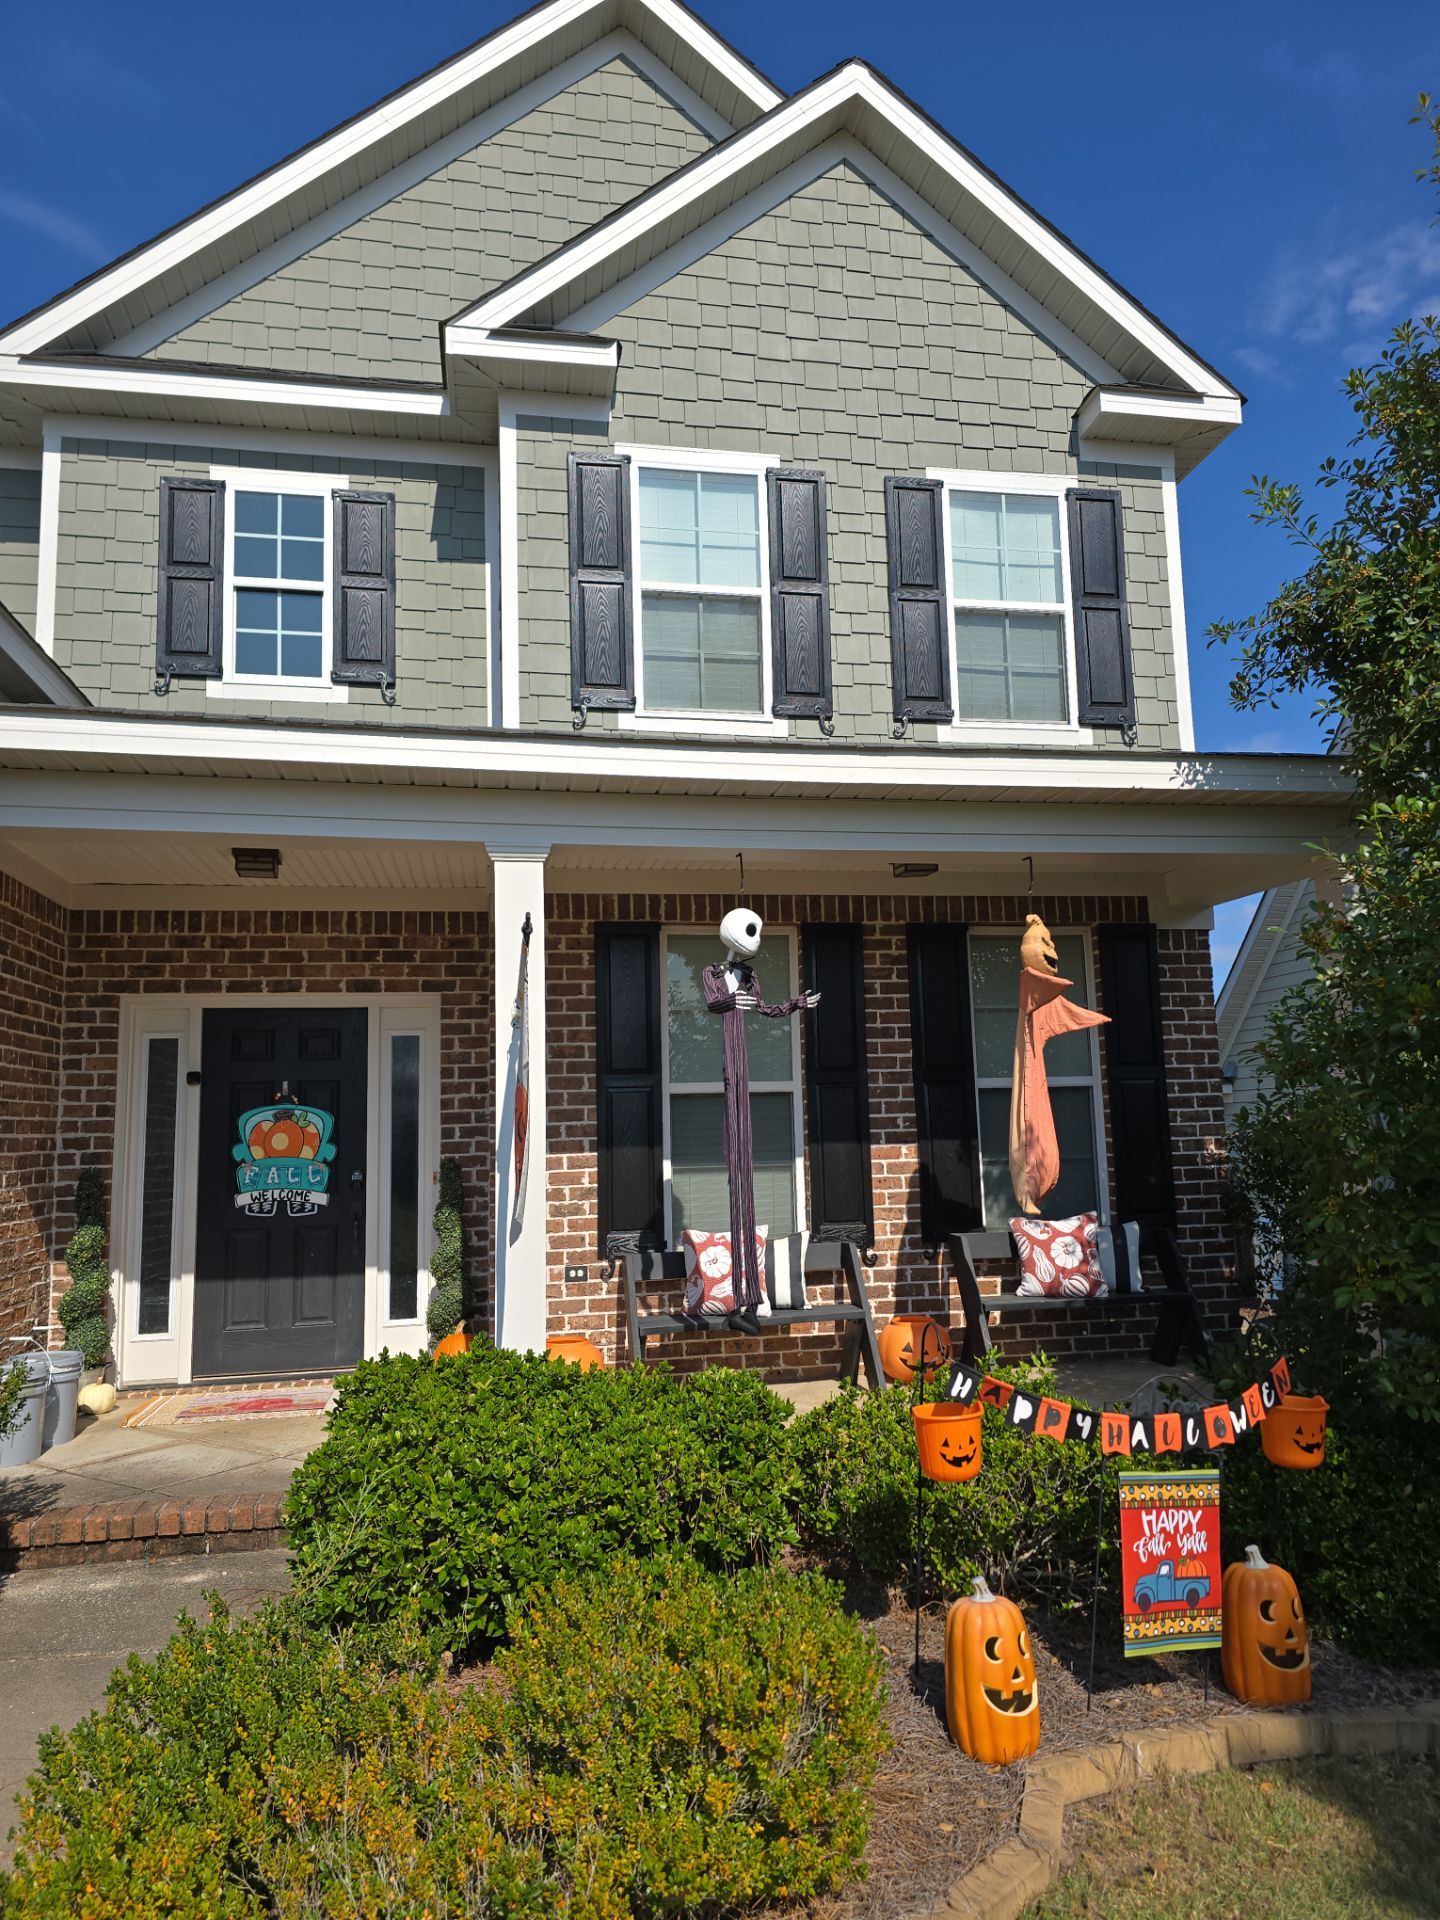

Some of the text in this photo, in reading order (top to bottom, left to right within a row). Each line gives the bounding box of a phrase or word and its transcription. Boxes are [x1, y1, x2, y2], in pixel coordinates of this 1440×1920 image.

[244, 1166, 321, 1183] FALL
[250, 1190, 311, 1202] WELCOME
[950, 1372, 1290, 1450] HAPPY HALLOWEEN
[1141, 1509, 1202, 1536] HAPPY
